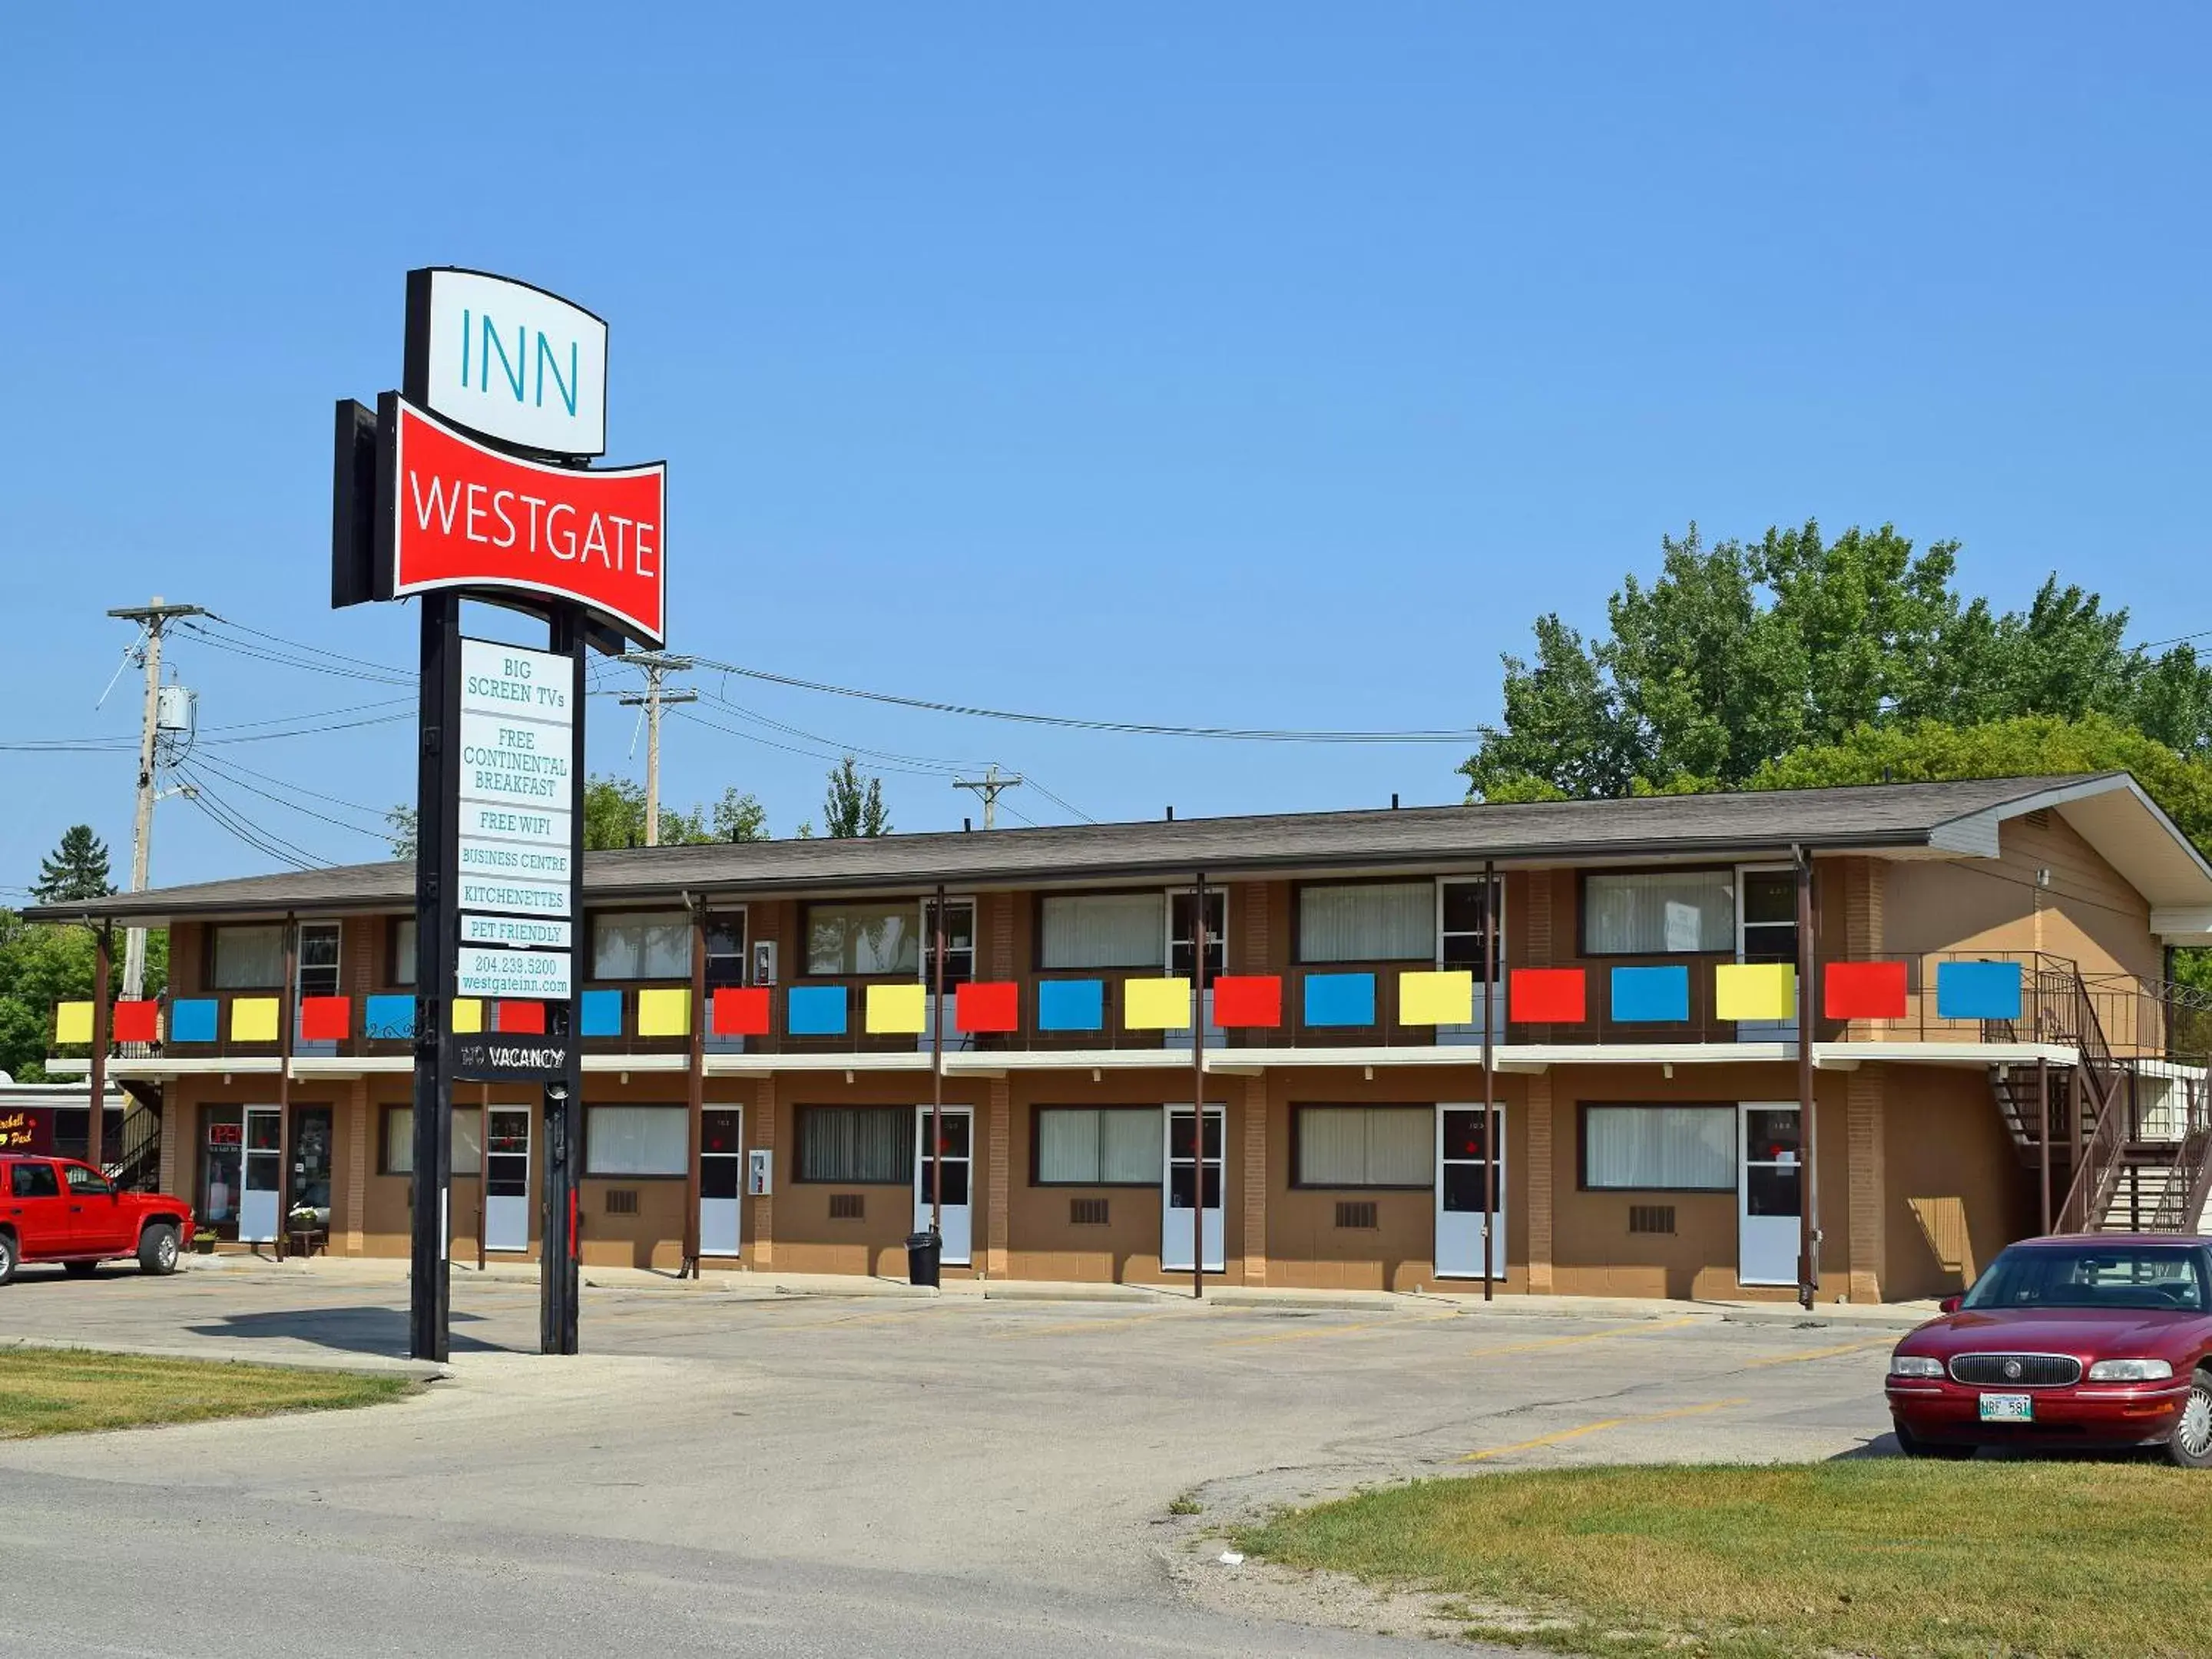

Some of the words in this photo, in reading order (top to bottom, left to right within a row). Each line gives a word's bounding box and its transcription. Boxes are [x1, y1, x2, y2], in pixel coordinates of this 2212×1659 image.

[462, 309, 578, 417] INN
[409, 469, 656, 578] WESTGATE
[503, 658, 531, 678] BIG
[468, 676, 532, 703] SCREEN
[536, 687, 565, 707] TVs
[498, 728, 535, 750] FREE
[463, 747, 568, 777] CONTINENTAL
[475, 770, 556, 796] BREAKFAST
[479, 812, 516, 831] FREE
[518, 816, 551, 836] WIFI
[462, 848, 518, 867] BUSINESS
[521, 853, 567, 872] CENTRE
[464, 885, 564, 908] KITCHENETTES
[471, 921, 496, 938] PET
[498, 923, 562, 942] FRIENDLY
[475, 955, 557, 975] 204.239.5200
[462, 974, 568, 995] westgateinn.com
[488, 1046, 566, 1069] VACANCY
